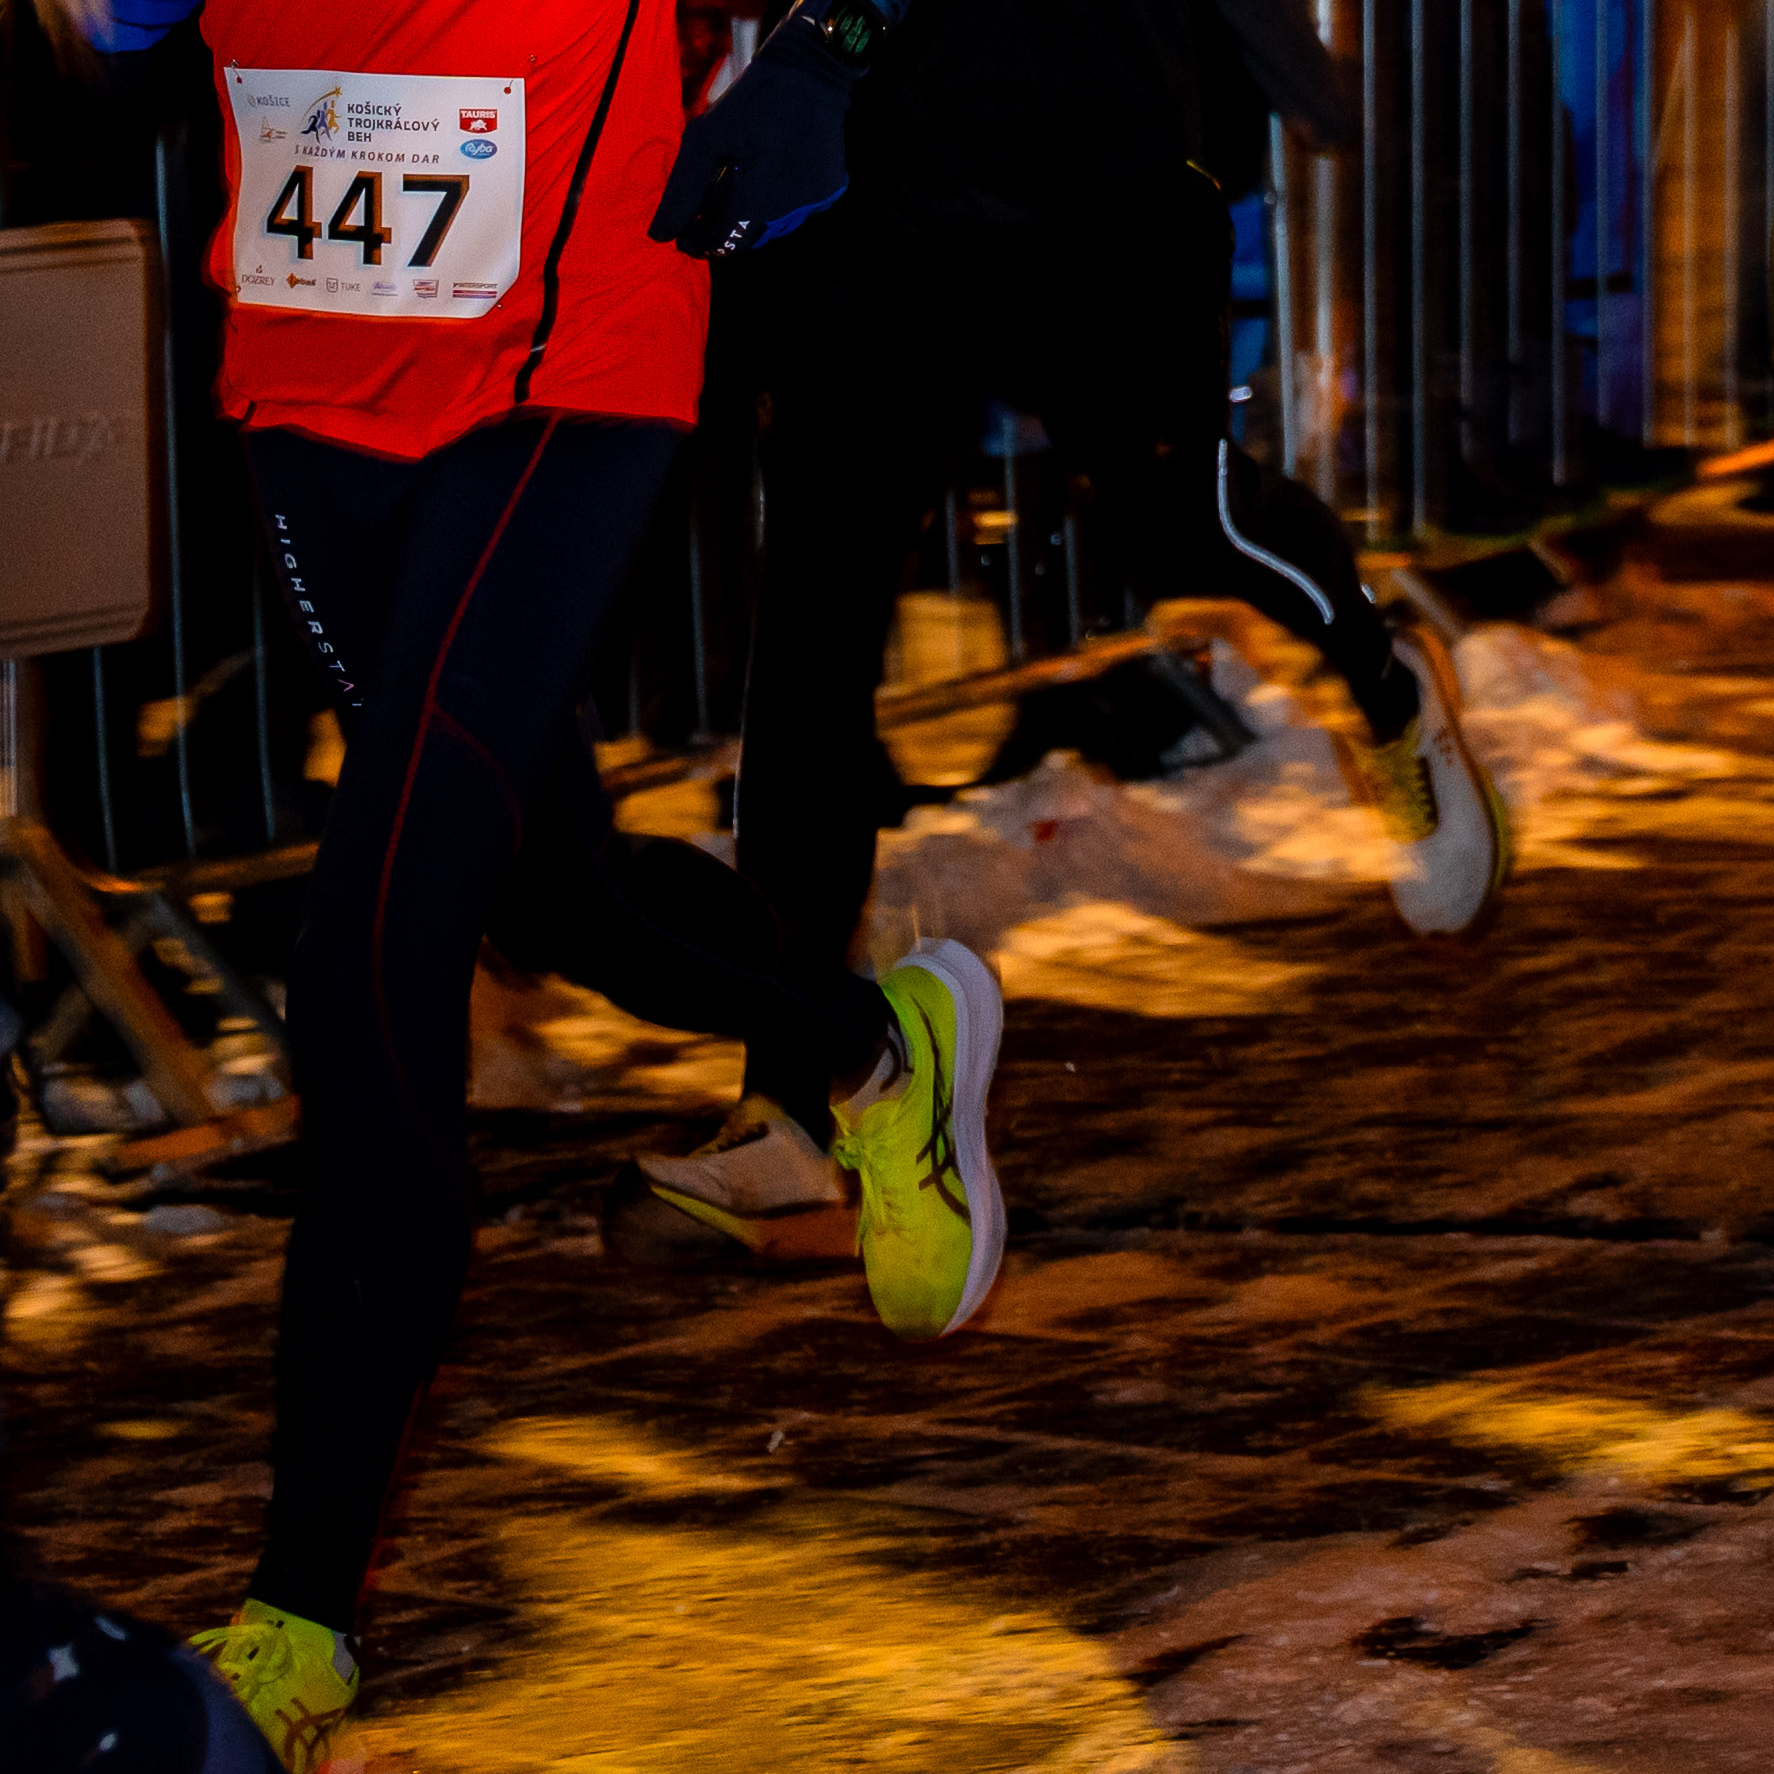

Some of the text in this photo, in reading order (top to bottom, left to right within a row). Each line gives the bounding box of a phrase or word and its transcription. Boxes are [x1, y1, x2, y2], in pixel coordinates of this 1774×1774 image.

[257, 94, 291, 108] KOŠICE
[347, 101, 402, 117] KOŠICKÝ
[460, 110, 496, 119] TAURIS
[347, 116, 440, 132] TROJKRÁĽOVÝ
[347, 131, 372, 143] BEH
[302, 146, 346, 159] KAŽDÝM
[351, 150, 406, 164] KROKOM
[411, 154, 440, 164] DAR
[464, 141, 494, 157] Ryba
[265, 164, 471, 268] 447
[340, 282, 361, 292] TUKE
